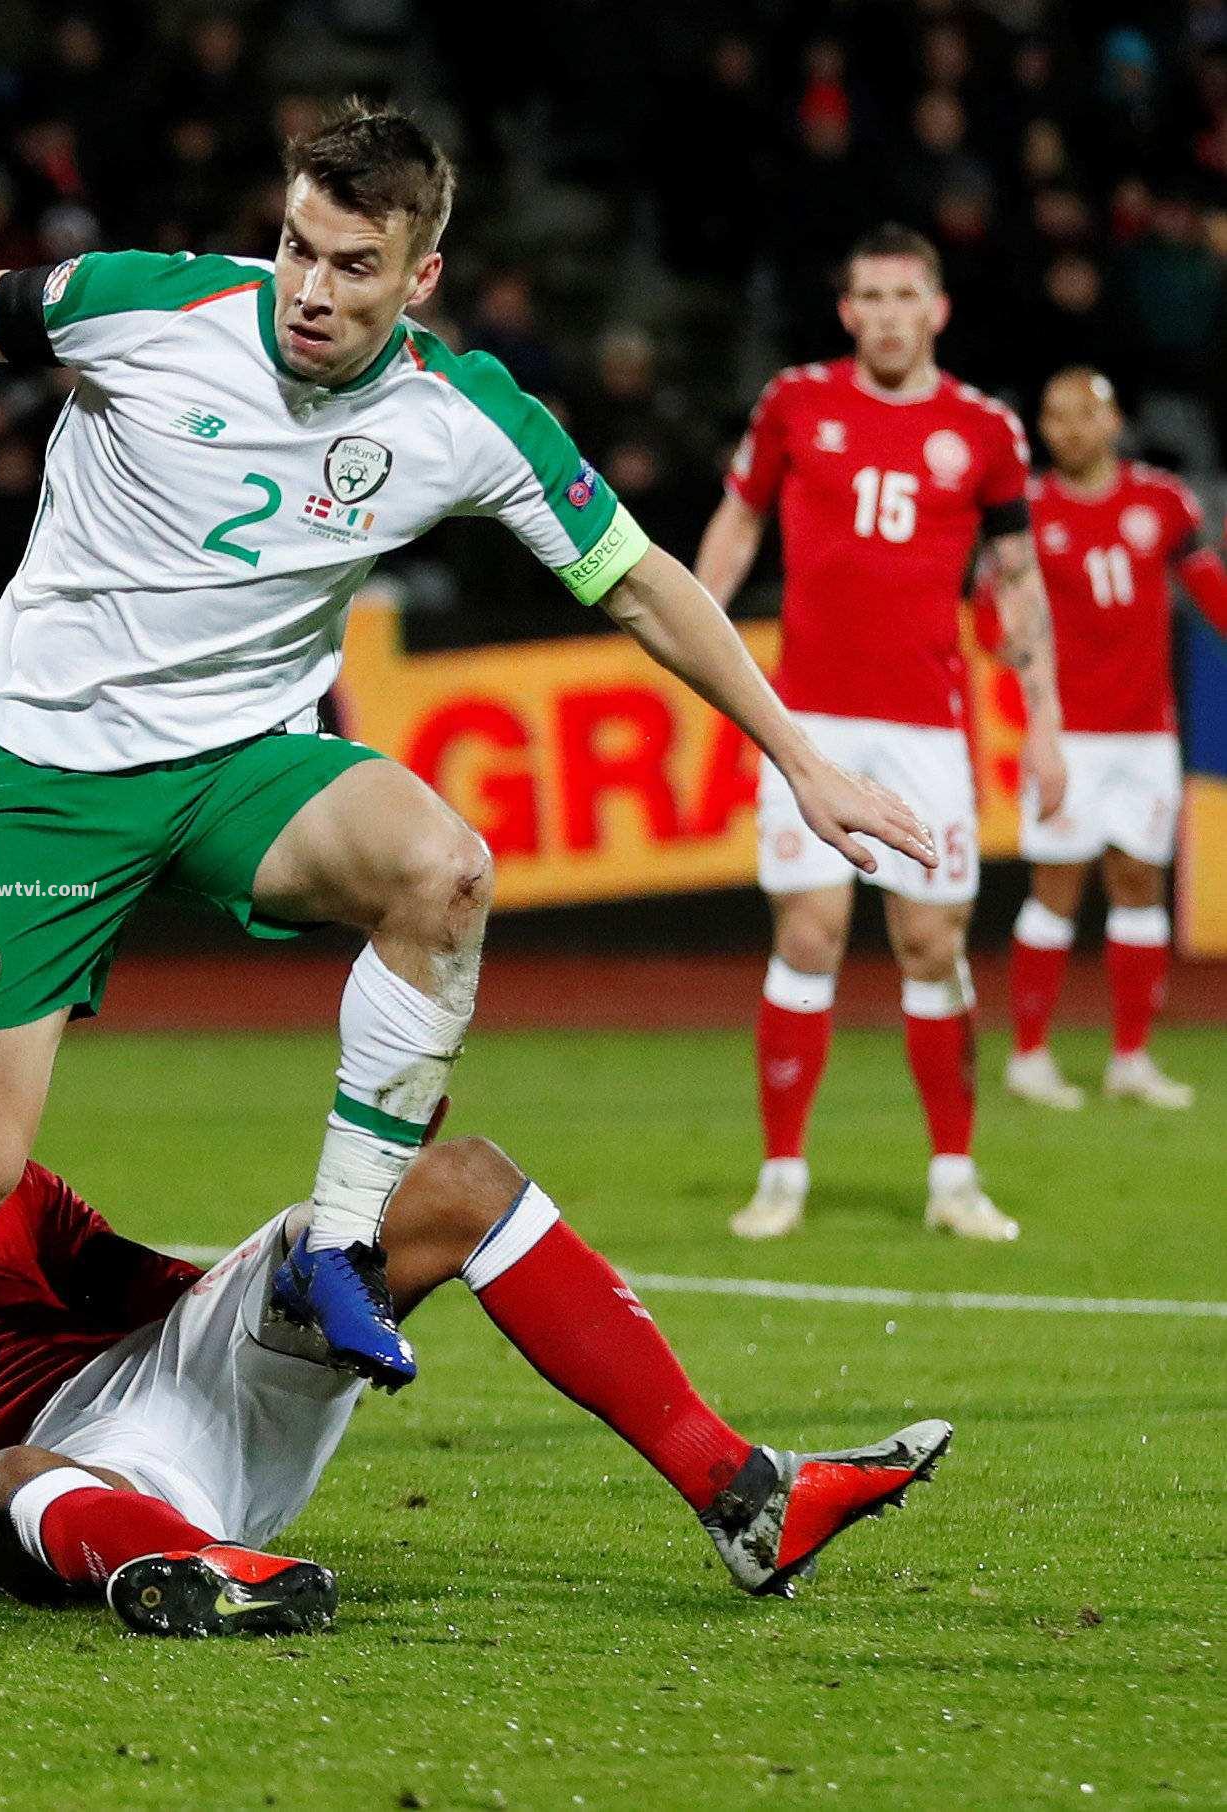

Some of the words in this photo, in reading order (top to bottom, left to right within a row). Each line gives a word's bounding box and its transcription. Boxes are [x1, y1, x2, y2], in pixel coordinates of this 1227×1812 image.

[341, 443, 382, 463] Ireland
[202, 471, 283, 569] 2
[852, 466, 920, 544] 15
[570, 526, 623, 581] RESPECT
[1085, 545, 1136, 608] 11
